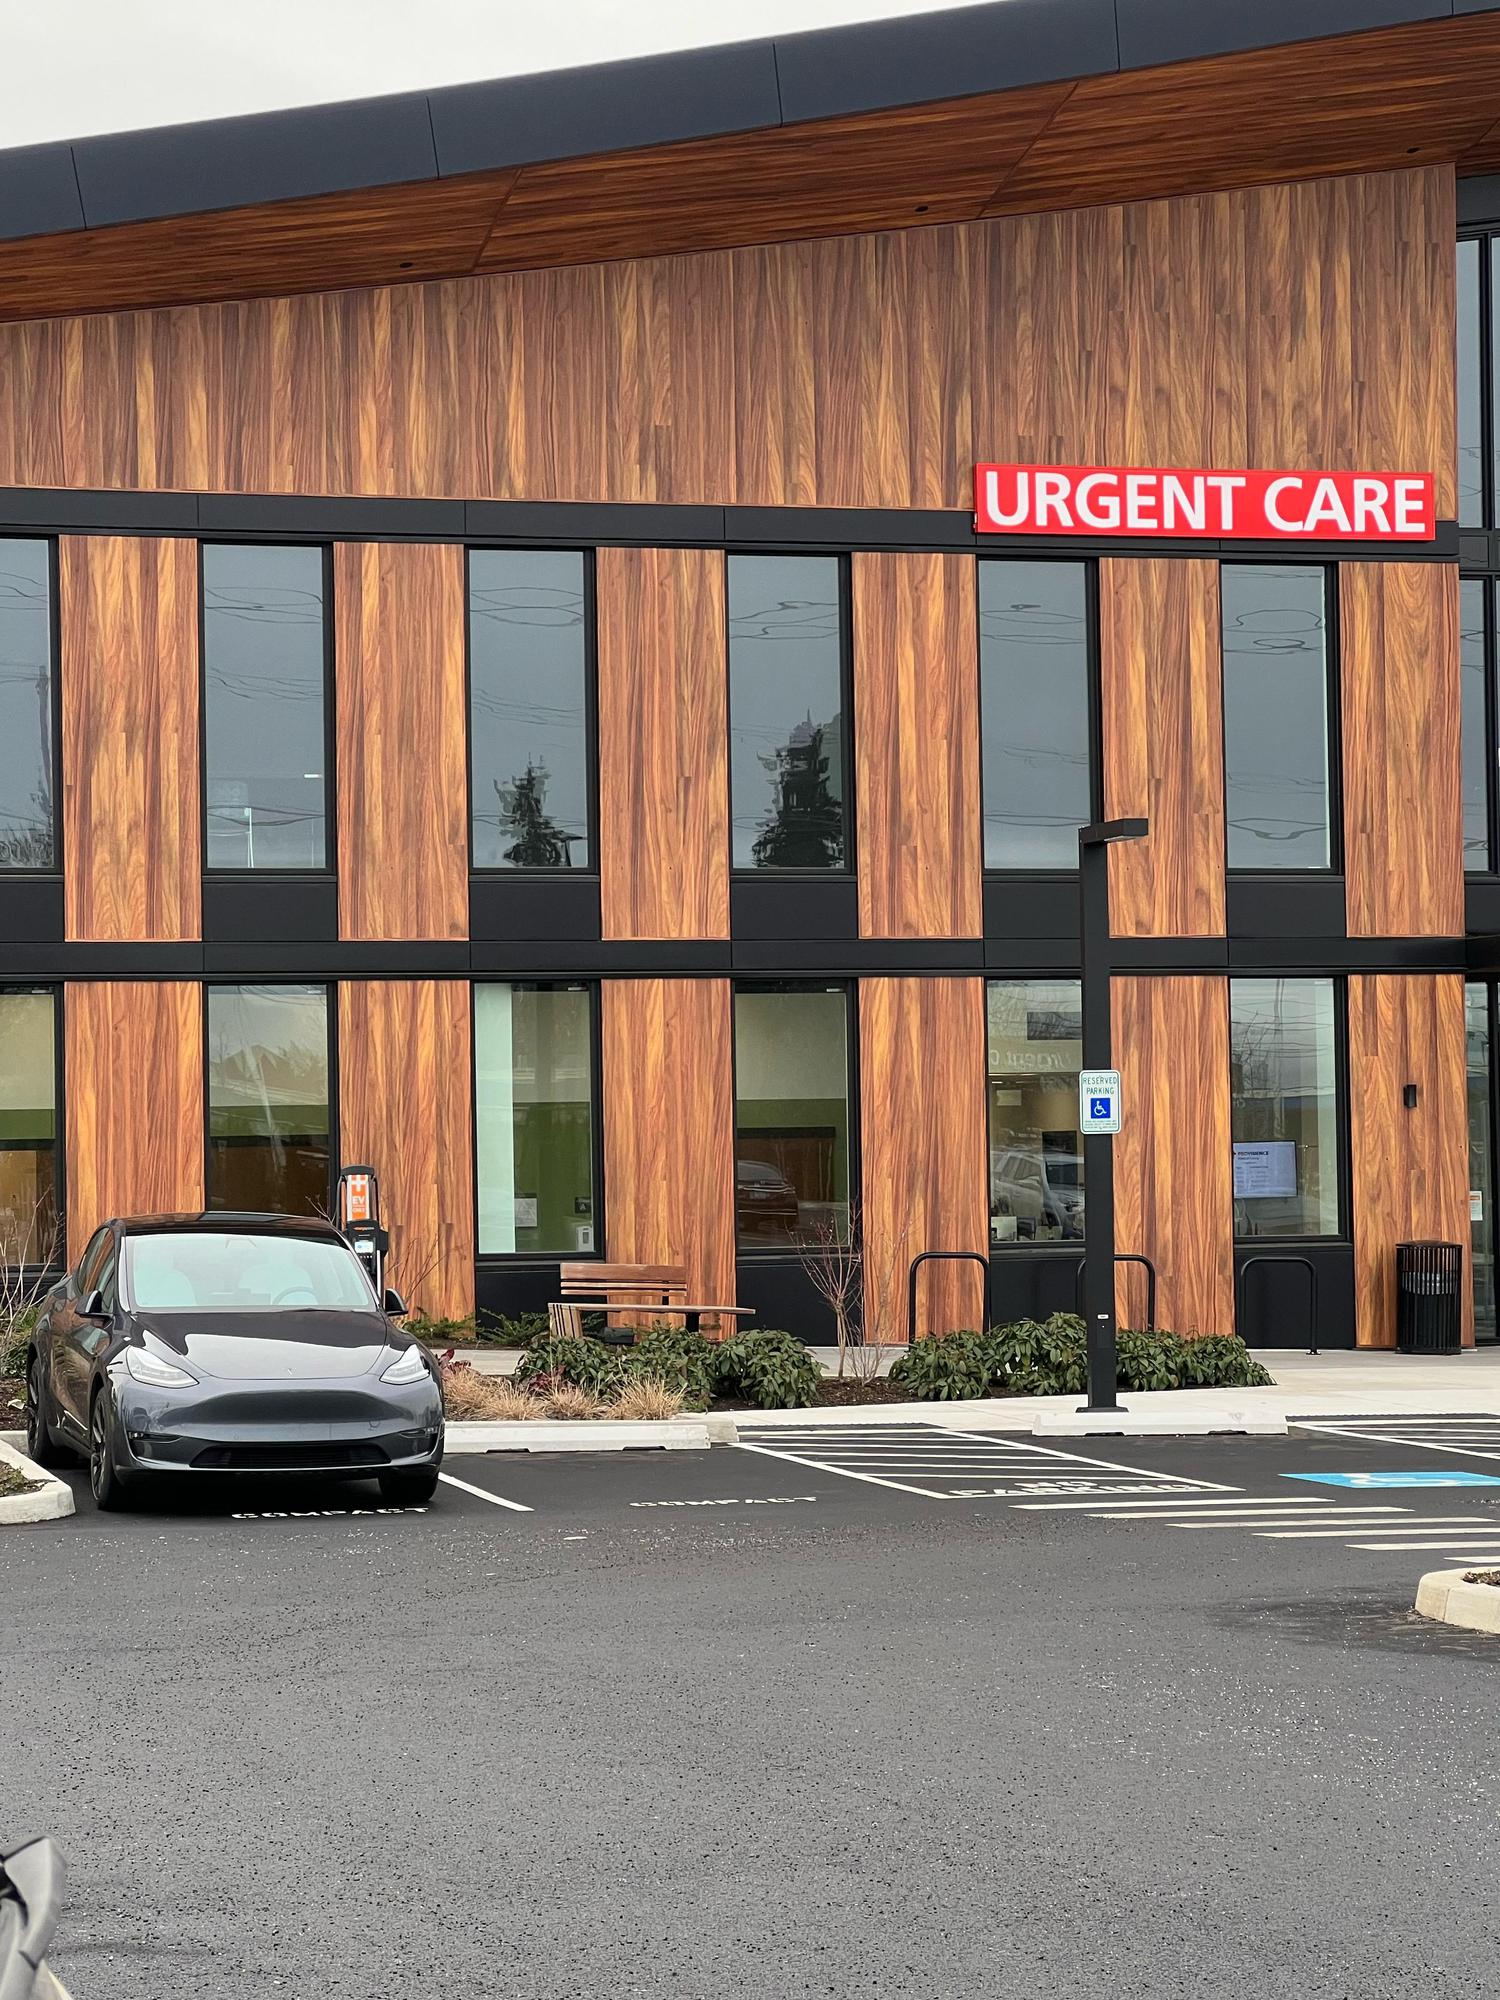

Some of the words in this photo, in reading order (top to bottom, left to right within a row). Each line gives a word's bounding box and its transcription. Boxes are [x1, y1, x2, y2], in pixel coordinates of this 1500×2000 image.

[985, 471, 1246, 531] URGENT
[1264, 477, 1426, 534] CARE
[1082, 1076, 1118, 1085] RESERVED
[1086, 1086, 1115, 1095] PARKING
[352, 1195, 365, 1205] EV
[629, 1496, 817, 1507] COMPACT
[231, 1506, 430, 1519] COMPACT
